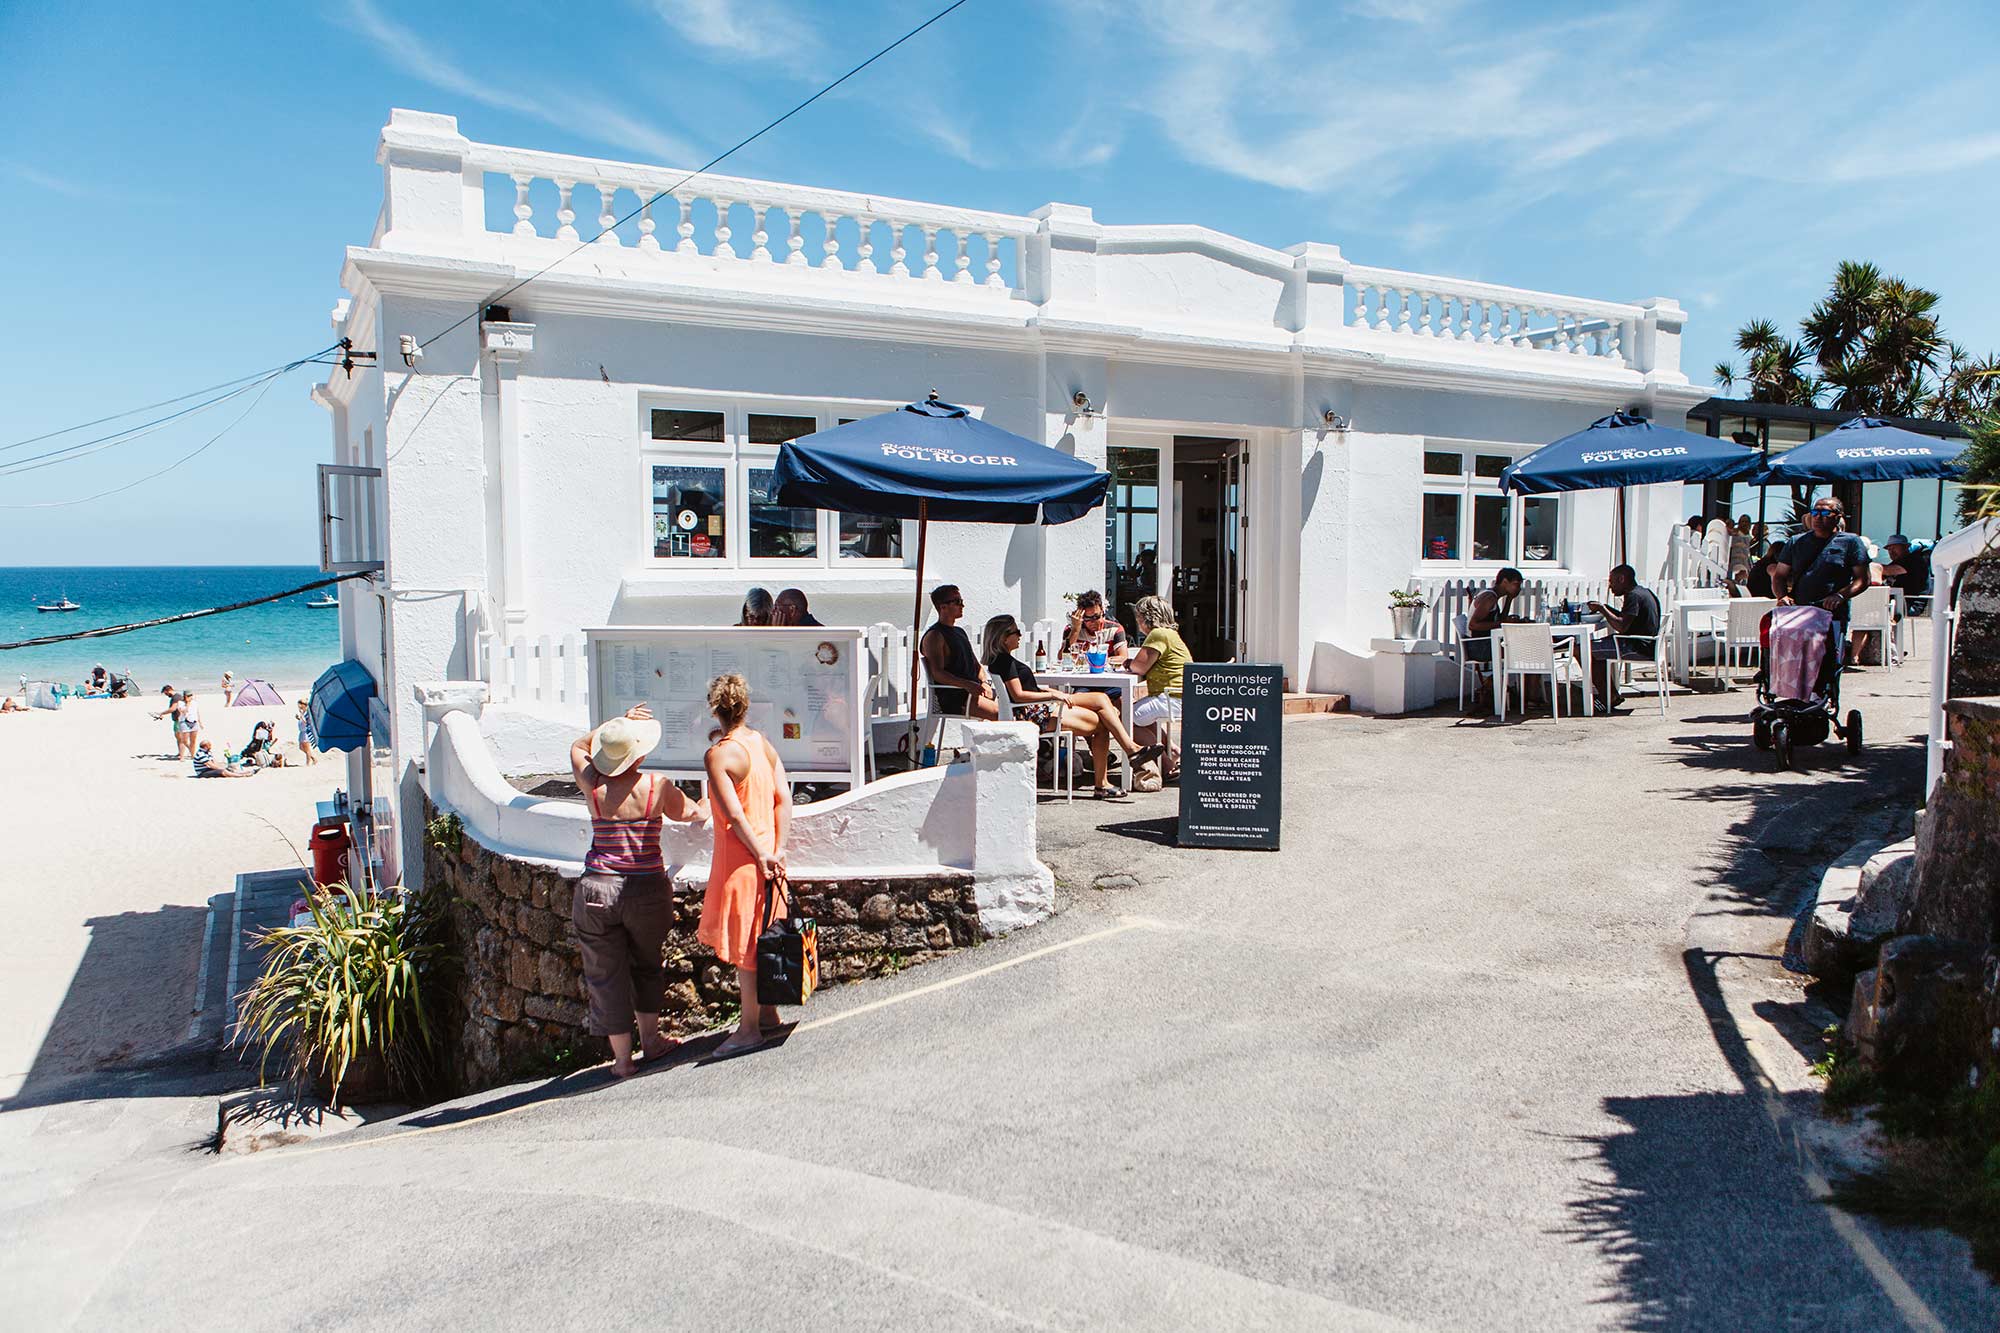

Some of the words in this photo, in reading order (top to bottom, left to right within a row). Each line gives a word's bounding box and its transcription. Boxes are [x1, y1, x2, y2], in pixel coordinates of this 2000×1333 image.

[881, 445, 930, 461] POL
[933, 452, 1018, 466] ROGER
[1581, 454, 1620, 463] POL
[1620, 447, 1688, 460] ROGER
[1836, 450, 1871, 459] POL
[1871, 448, 1932, 457] ROGER
[1191, 673, 1272, 685] Porthminster
[1195, 685, 1234, 696] Beach
[1238, 685, 1269, 697] Cafe
[1205, 707, 1256, 722] OPEN
[1220, 724, 1242, 733] FOR
